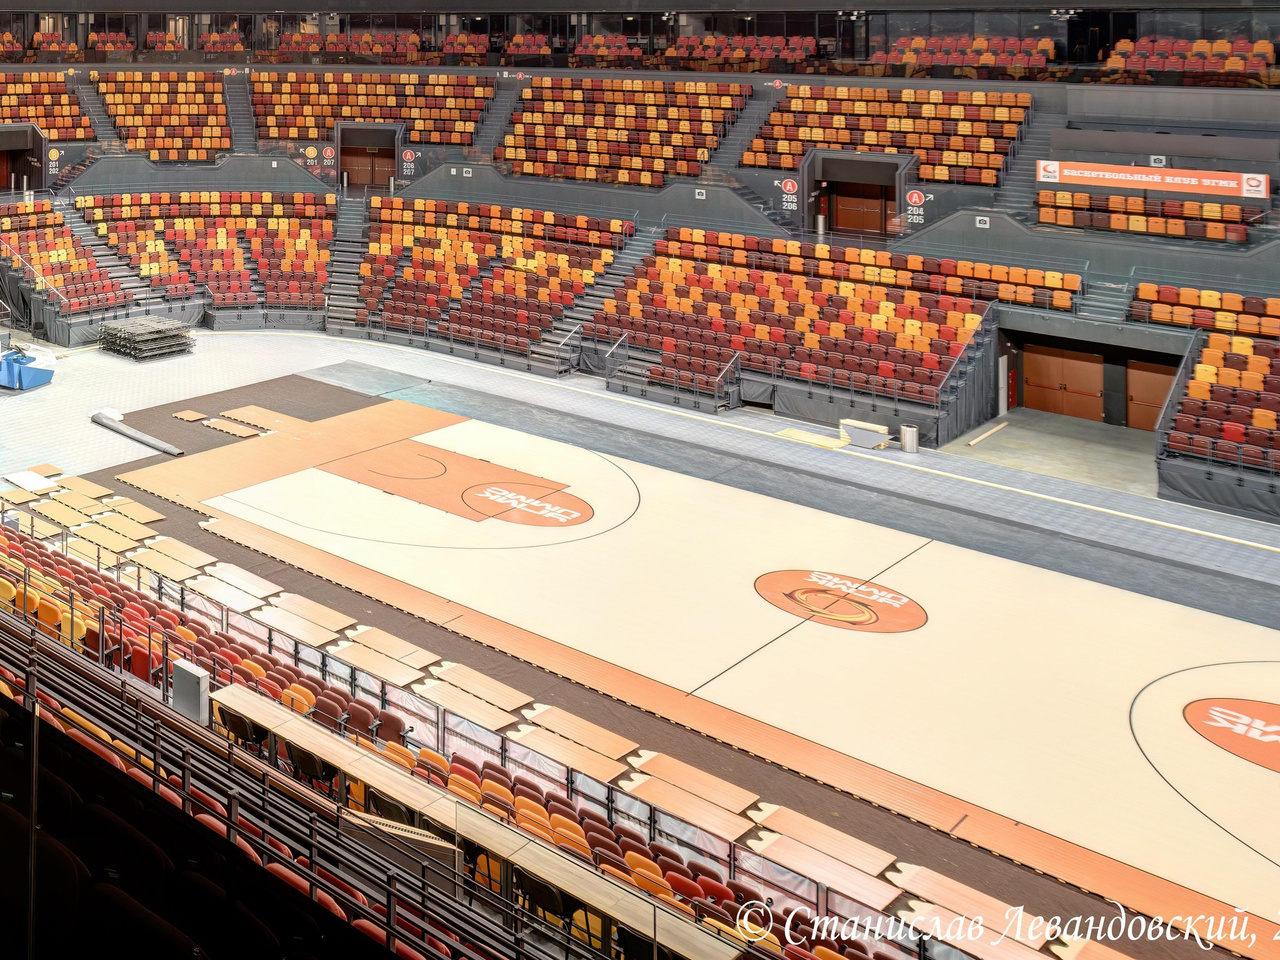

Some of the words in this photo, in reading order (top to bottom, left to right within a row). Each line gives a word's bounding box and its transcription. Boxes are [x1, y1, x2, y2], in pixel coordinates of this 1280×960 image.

[1201, 179, 1239, 188] УГМК
[782, 194, 798, 202] 205
[782, 202, 798, 210] 206
[907, 206, 925, 215] 204
[907, 215, 925, 224] 205
